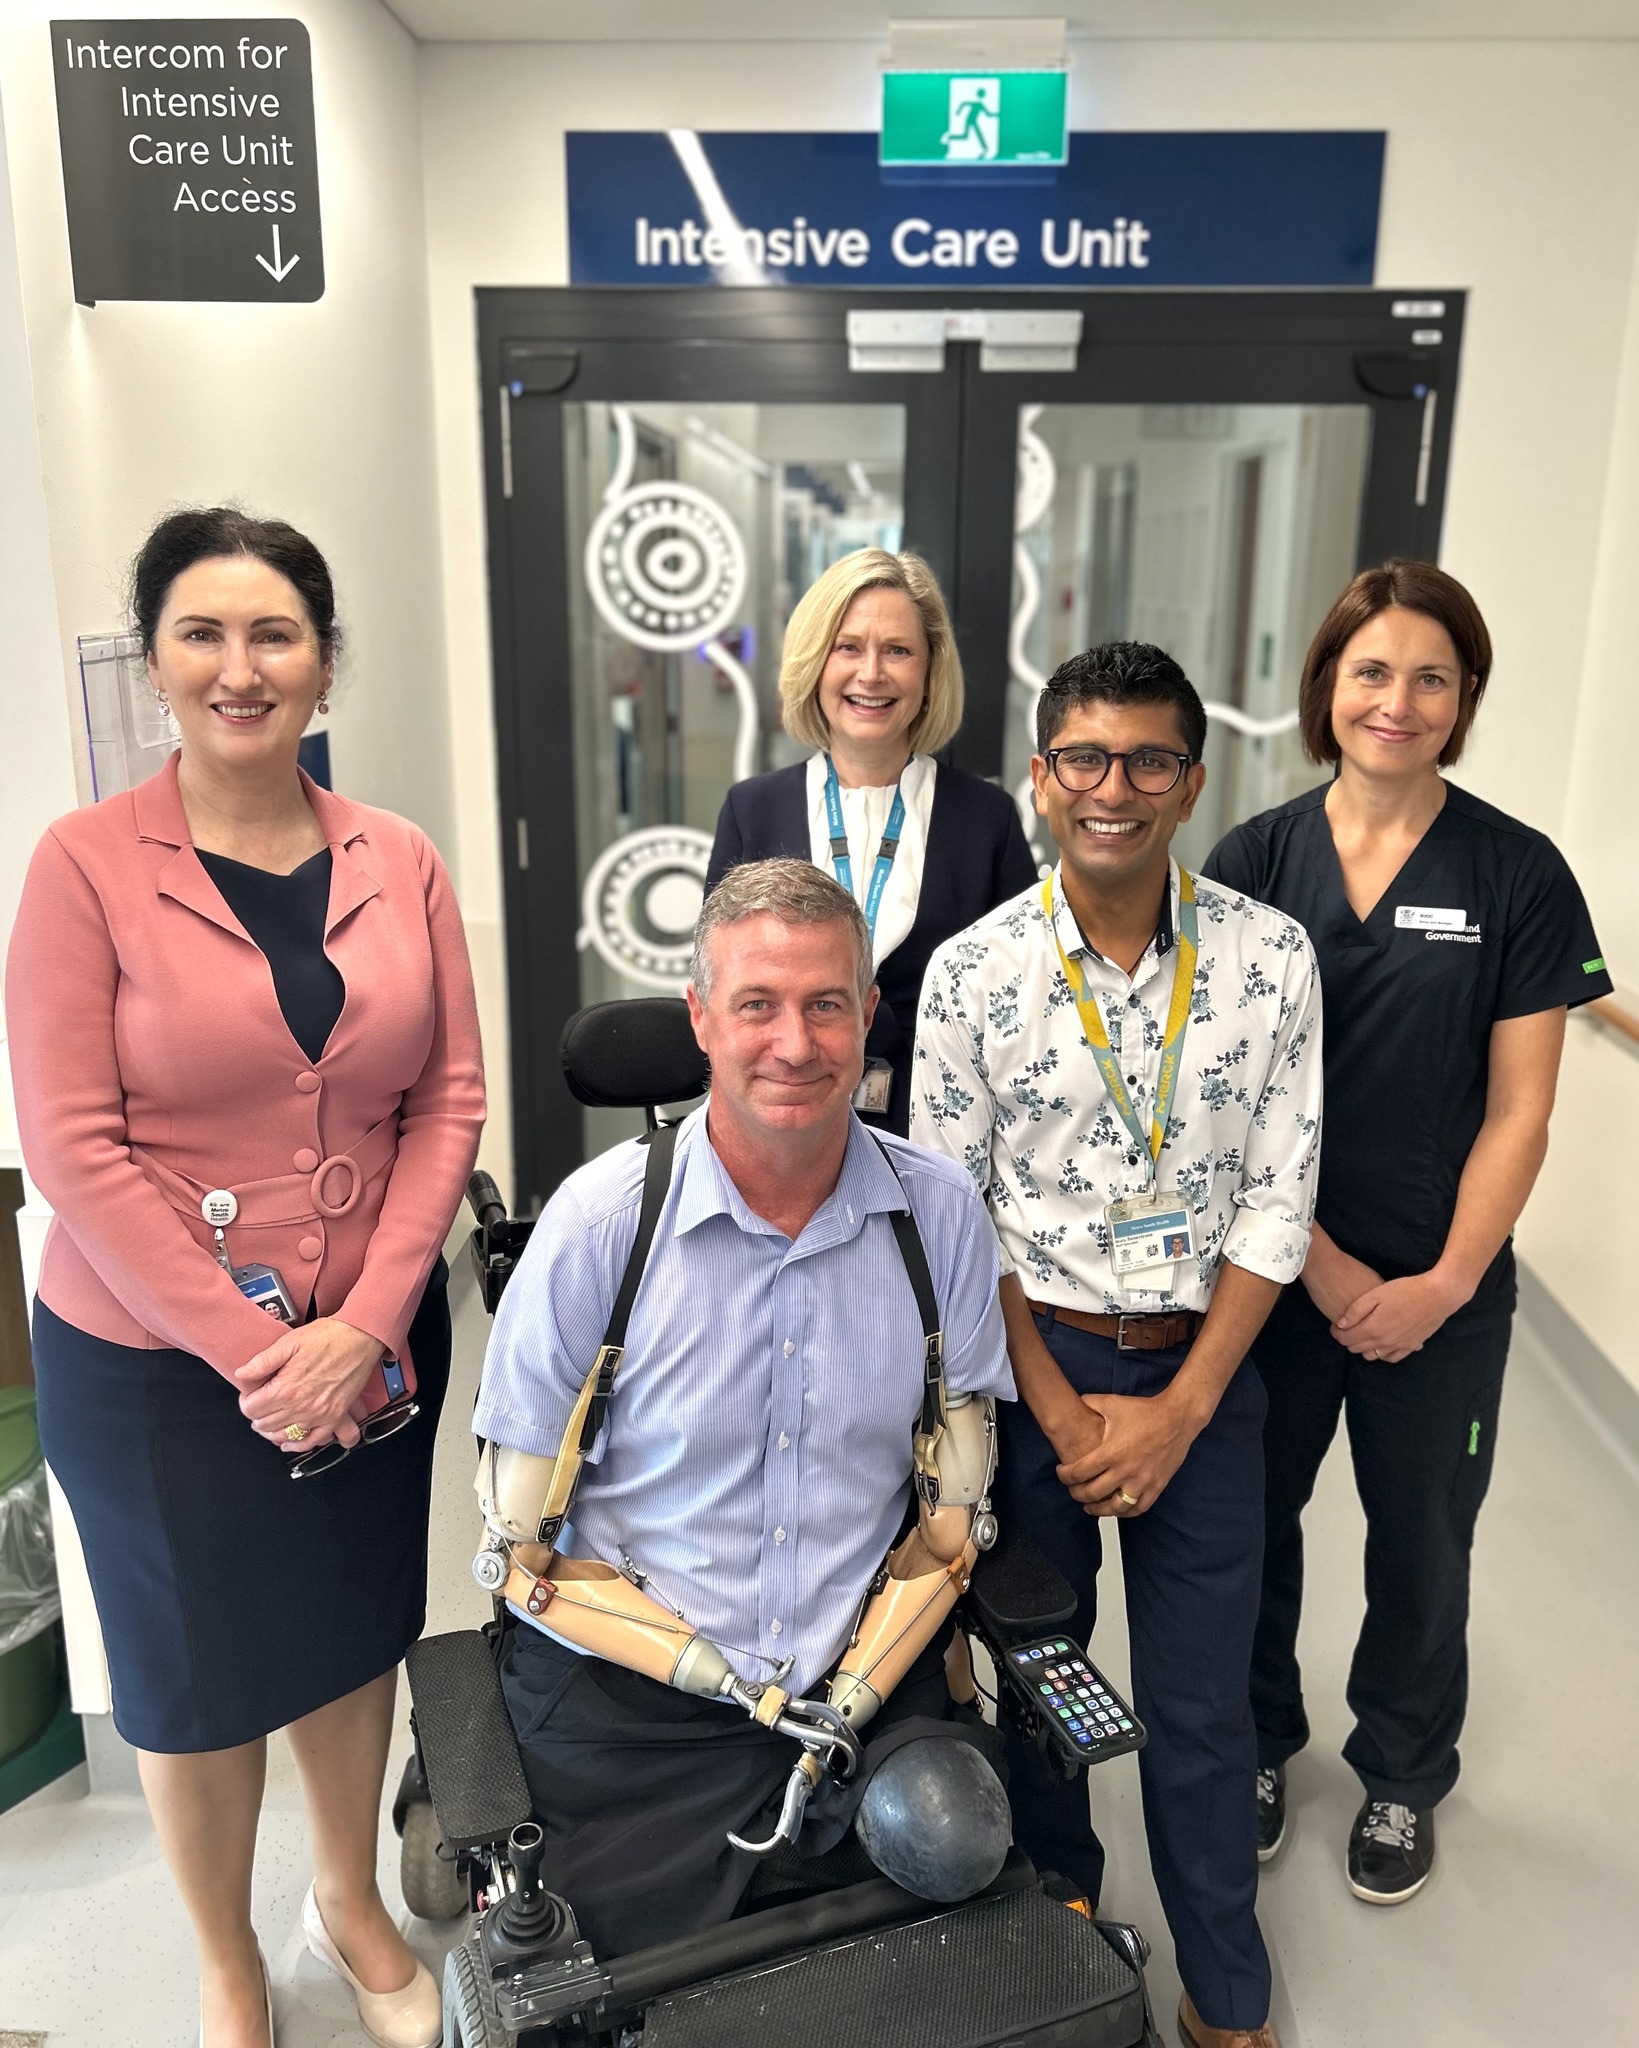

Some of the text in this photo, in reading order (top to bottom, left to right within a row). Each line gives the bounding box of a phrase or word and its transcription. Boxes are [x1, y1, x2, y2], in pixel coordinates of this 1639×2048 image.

[66, 37, 288, 69] Intercom for
[121, 86, 280, 118] Intensive
[129, 134, 294, 166] Care Unit
[635, 216, 1151, 269] Intensive Care Unit
[1425, 931, 1482, 943] Government
